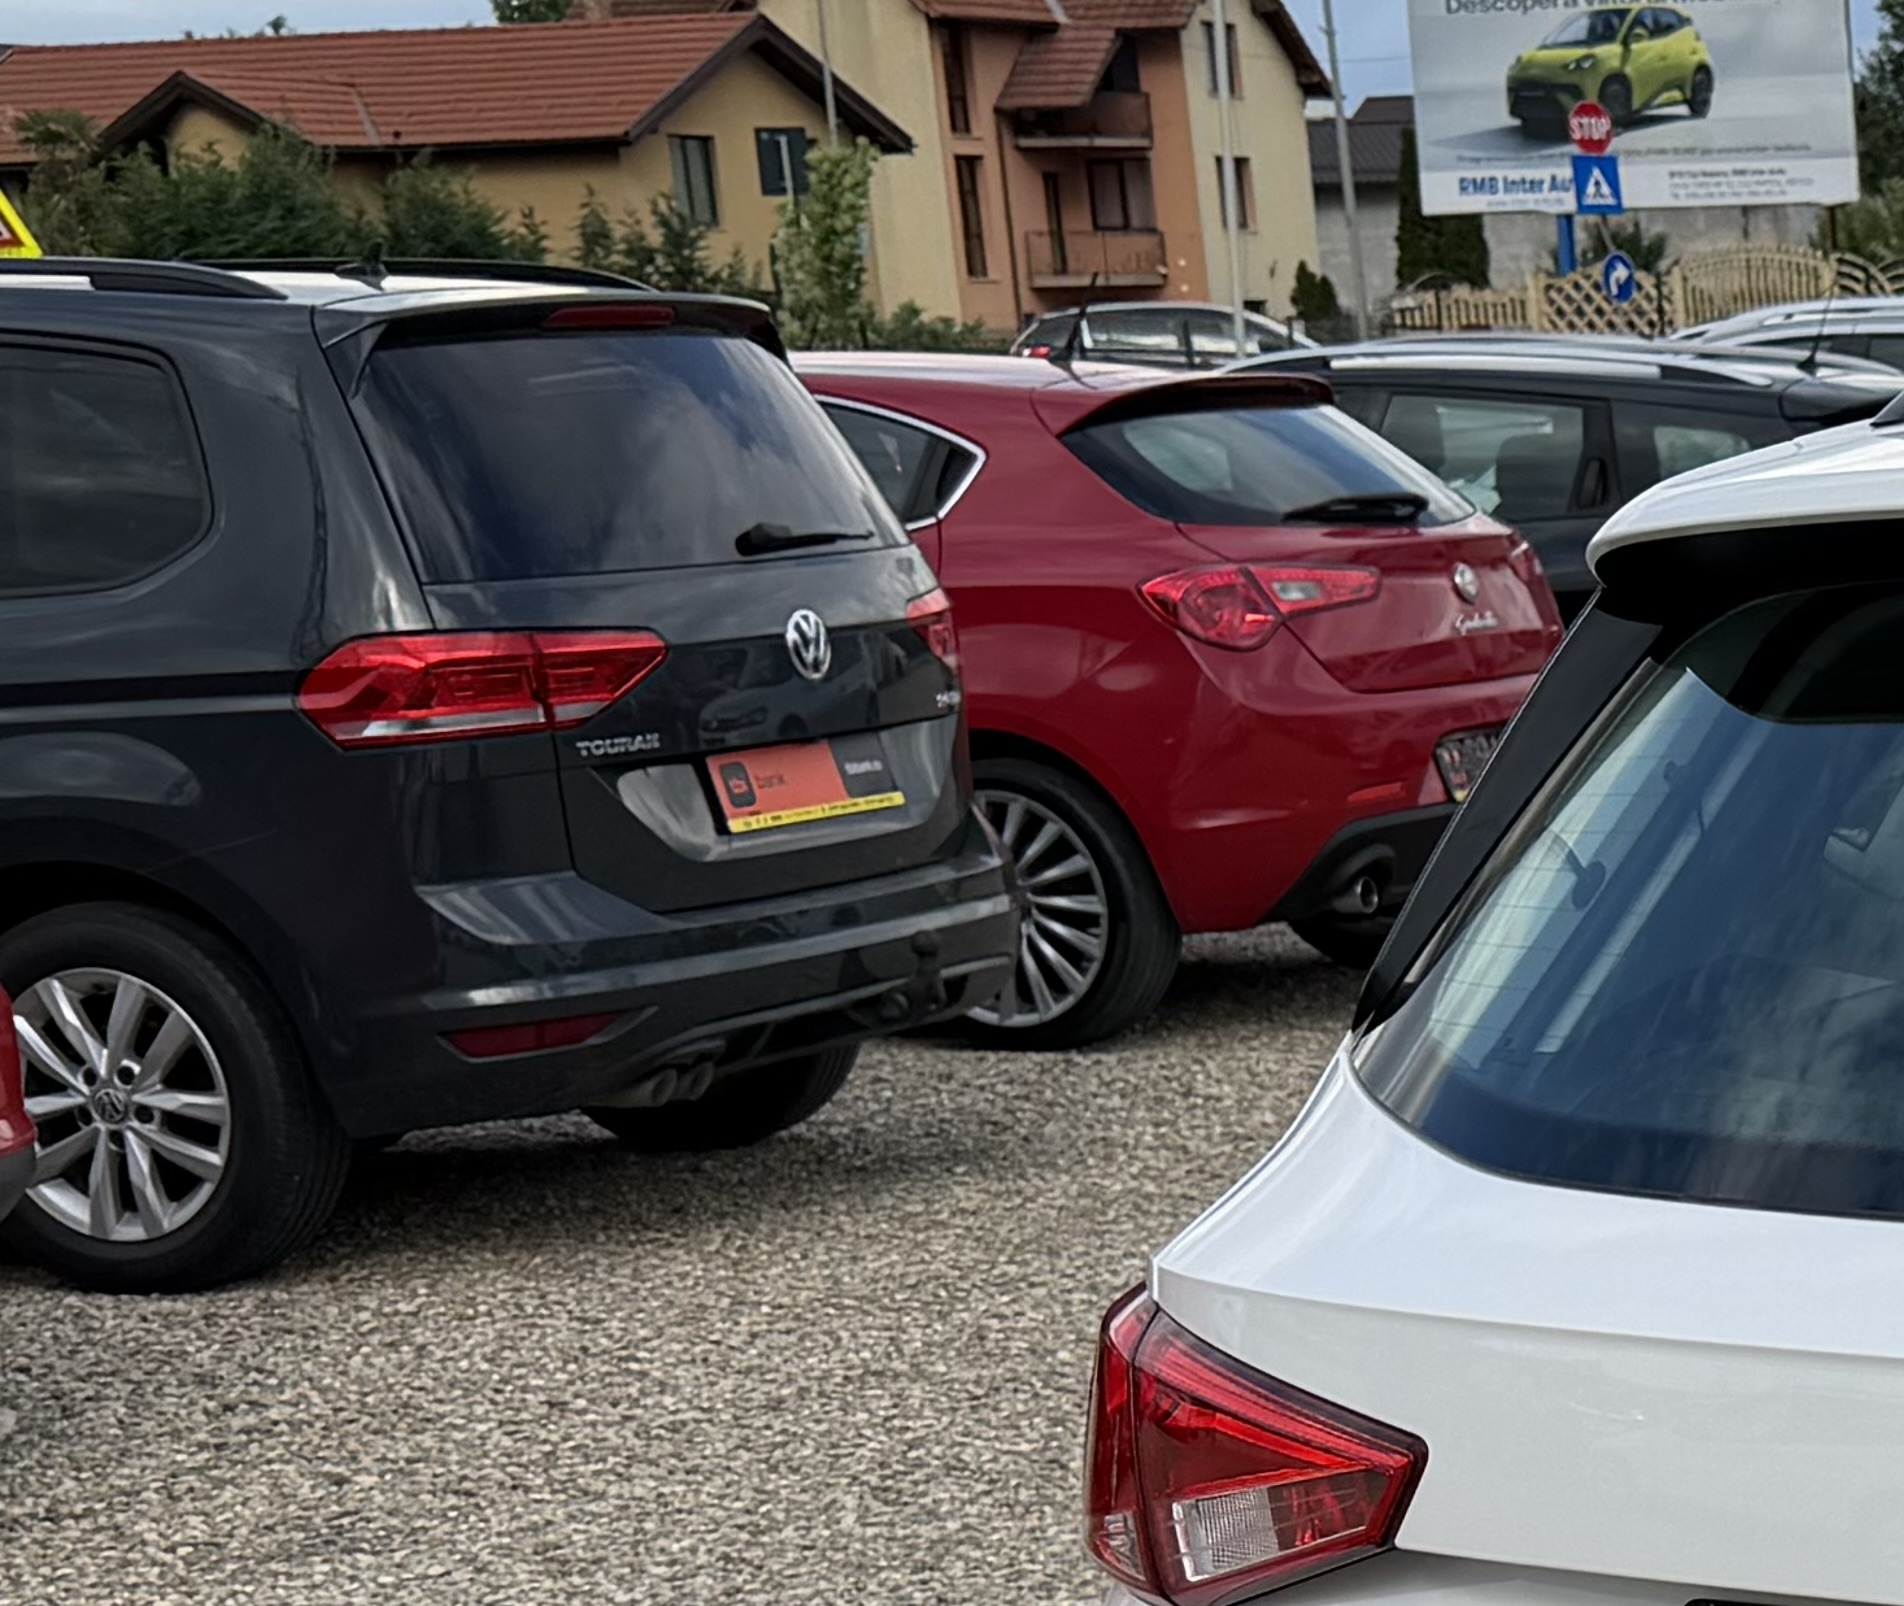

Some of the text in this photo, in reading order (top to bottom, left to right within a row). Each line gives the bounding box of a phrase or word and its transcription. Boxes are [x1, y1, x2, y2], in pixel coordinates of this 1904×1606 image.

[1569, 115, 1612, 141] STOP
[1459, 174, 1573, 196] RMB Inter Au
